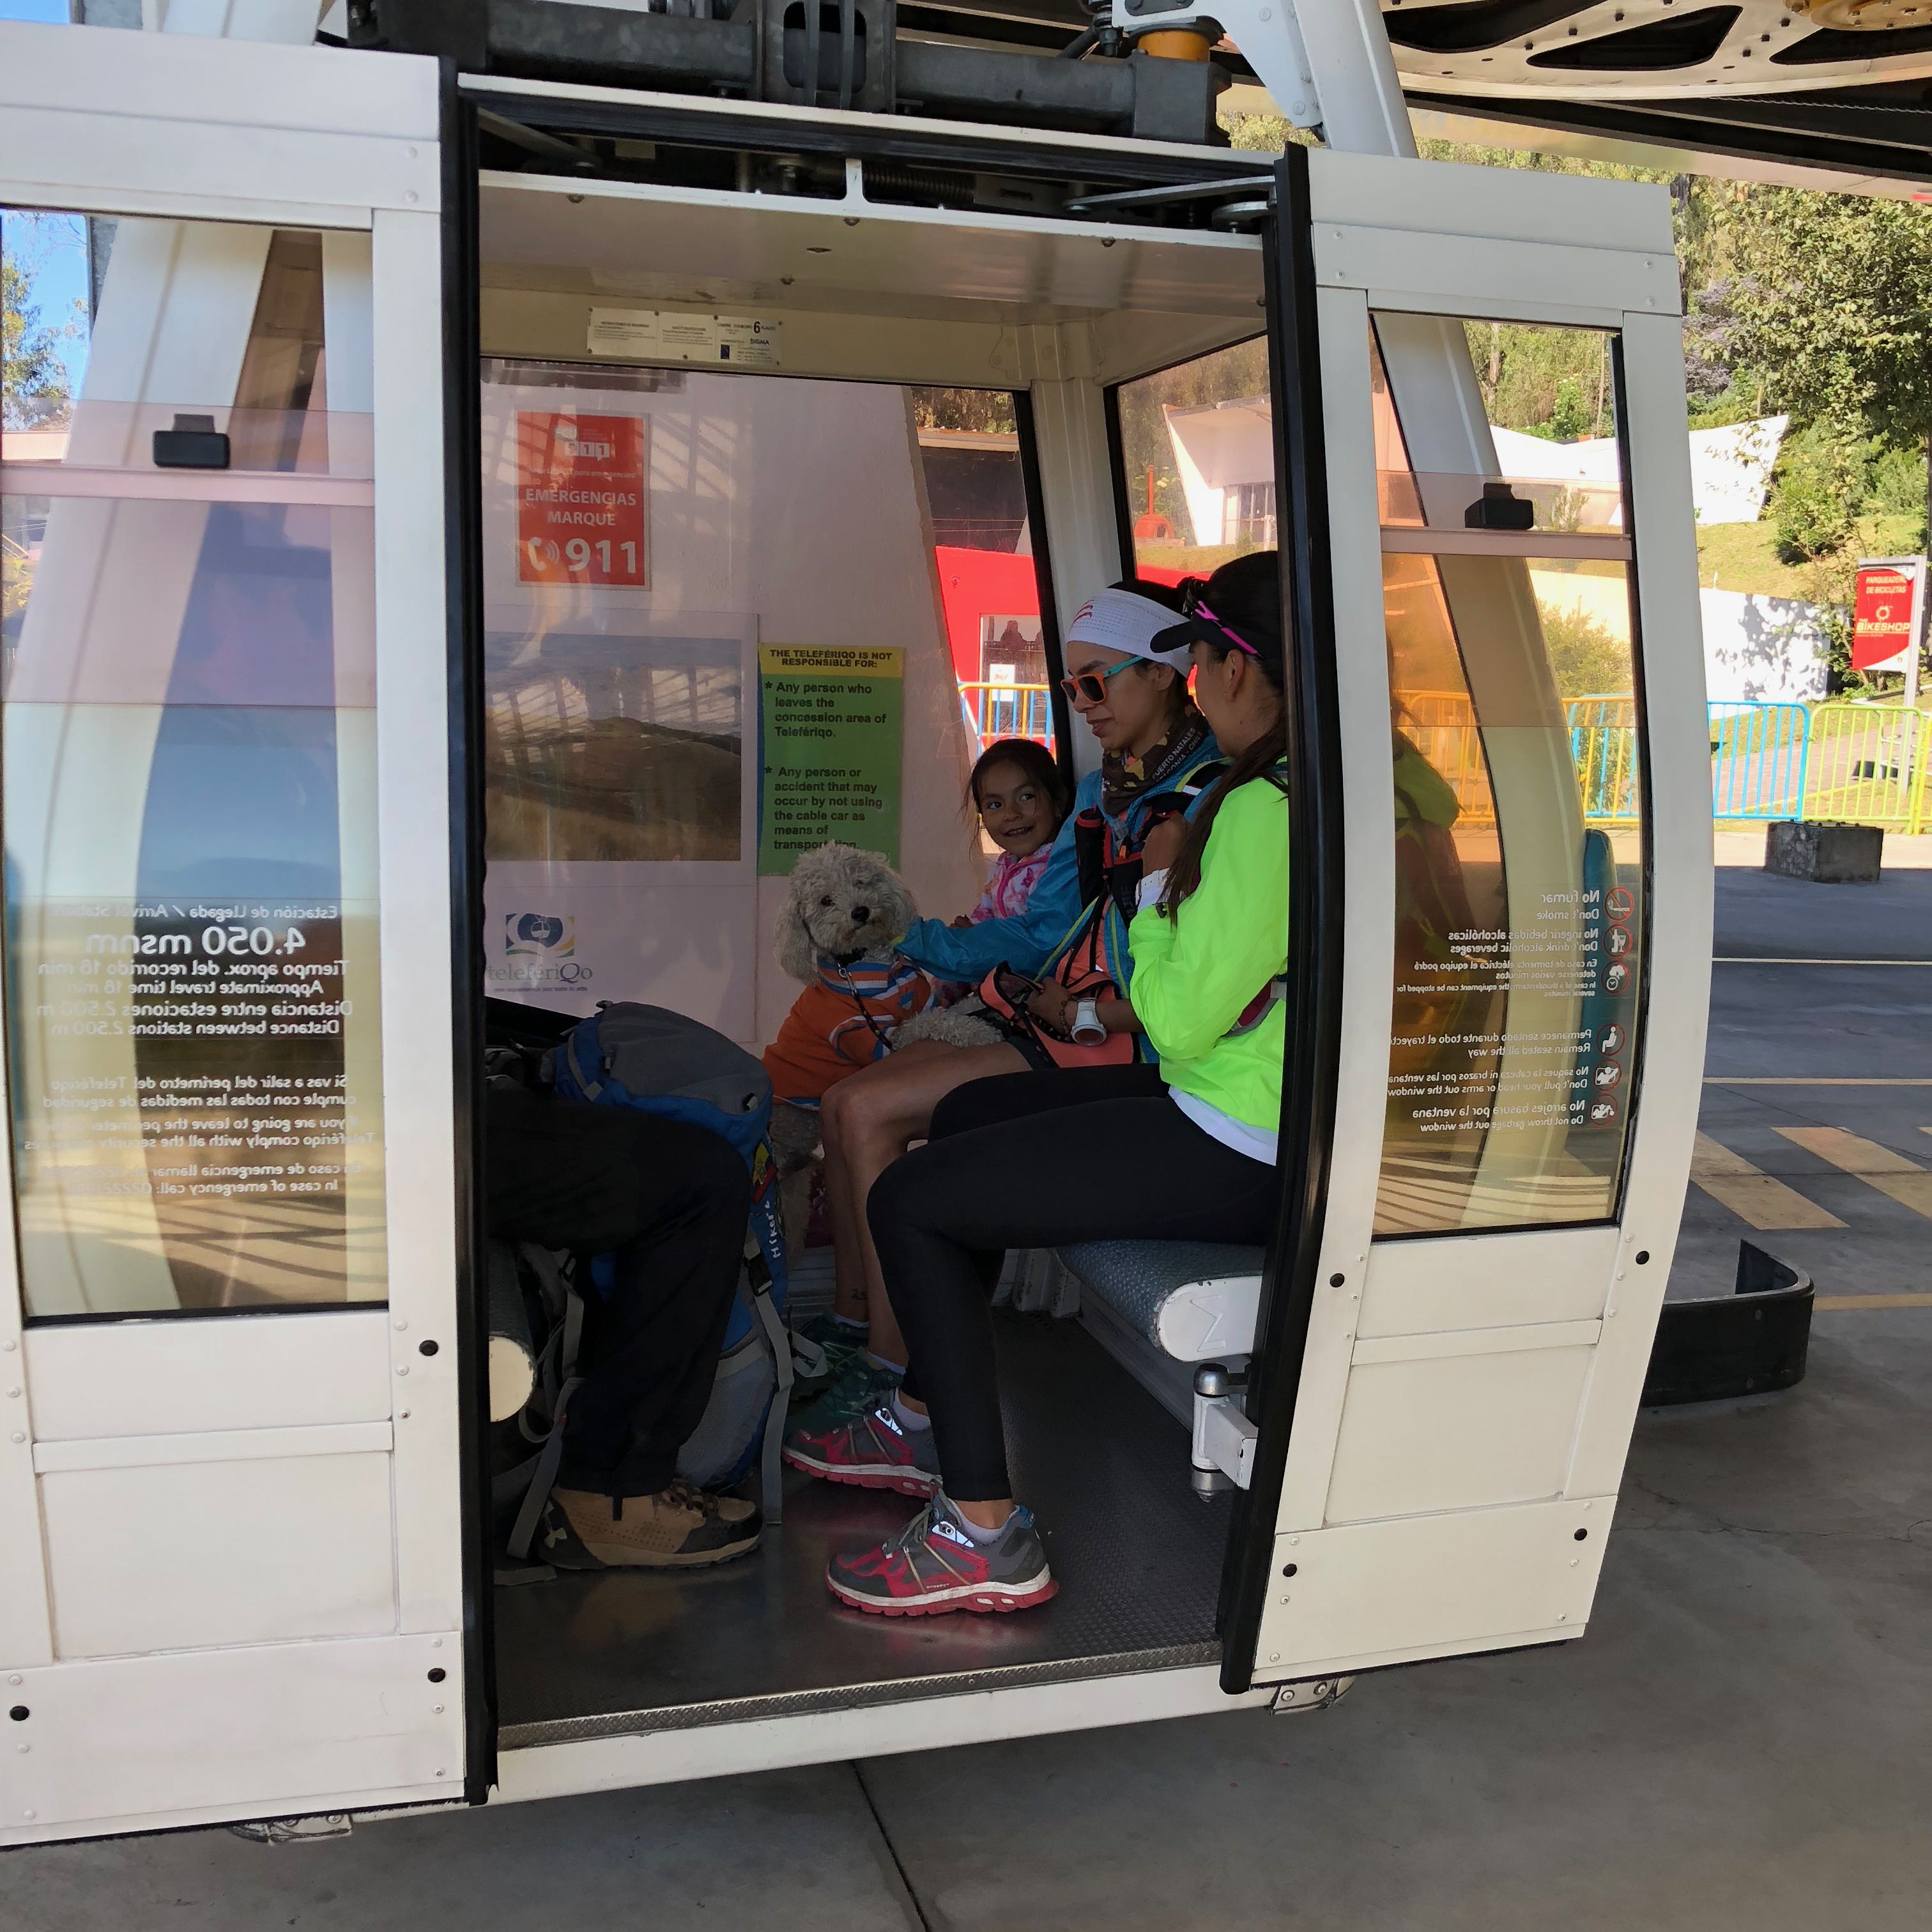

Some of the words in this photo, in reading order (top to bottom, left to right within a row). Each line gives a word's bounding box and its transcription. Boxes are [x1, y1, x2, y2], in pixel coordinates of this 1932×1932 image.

[754, 321, 760, 334] 6
[525, 489, 636, 505] EMERGENCIAS
[548, 511, 616, 526] MARQUE
[565, 538, 636, 574] 911
[1856, 622, 1910, 631] BIKESHOP
[770, 649, 790, 657] THE
[793, 648, 855, 659] TELEFÉRIQO
[782, 658, 852, 667] RESPONSIBLE
[776, 682, 800, 693] Any
[803, 684, 844, 694] person
[847, 684, 872, 694] who
[775, 697, 813, 707] leaves
[816, 697, 834, 707] the
[775, 712, 843, 723] concession
[846, 715, 871, 723] area
[874, 714, 887, 723] of
[1172, 727, 1196, 755] NATALES
[778, 767, 801, 778] Any
[805, 768, 846, 779] person
[849, 769, 861, 777] or
[774, 781, 824, 792] accident
[827, 782, 850, 792] that
[853, 784, 877, 794] may
[811, 796, 826, 808] by
[829, 797, 848, 806] not
[851, 798, 883, 809] using
[774, 811, 793, 820] the
[796, 811, 827, 821] cable
[816, 825, 829, 834] of
